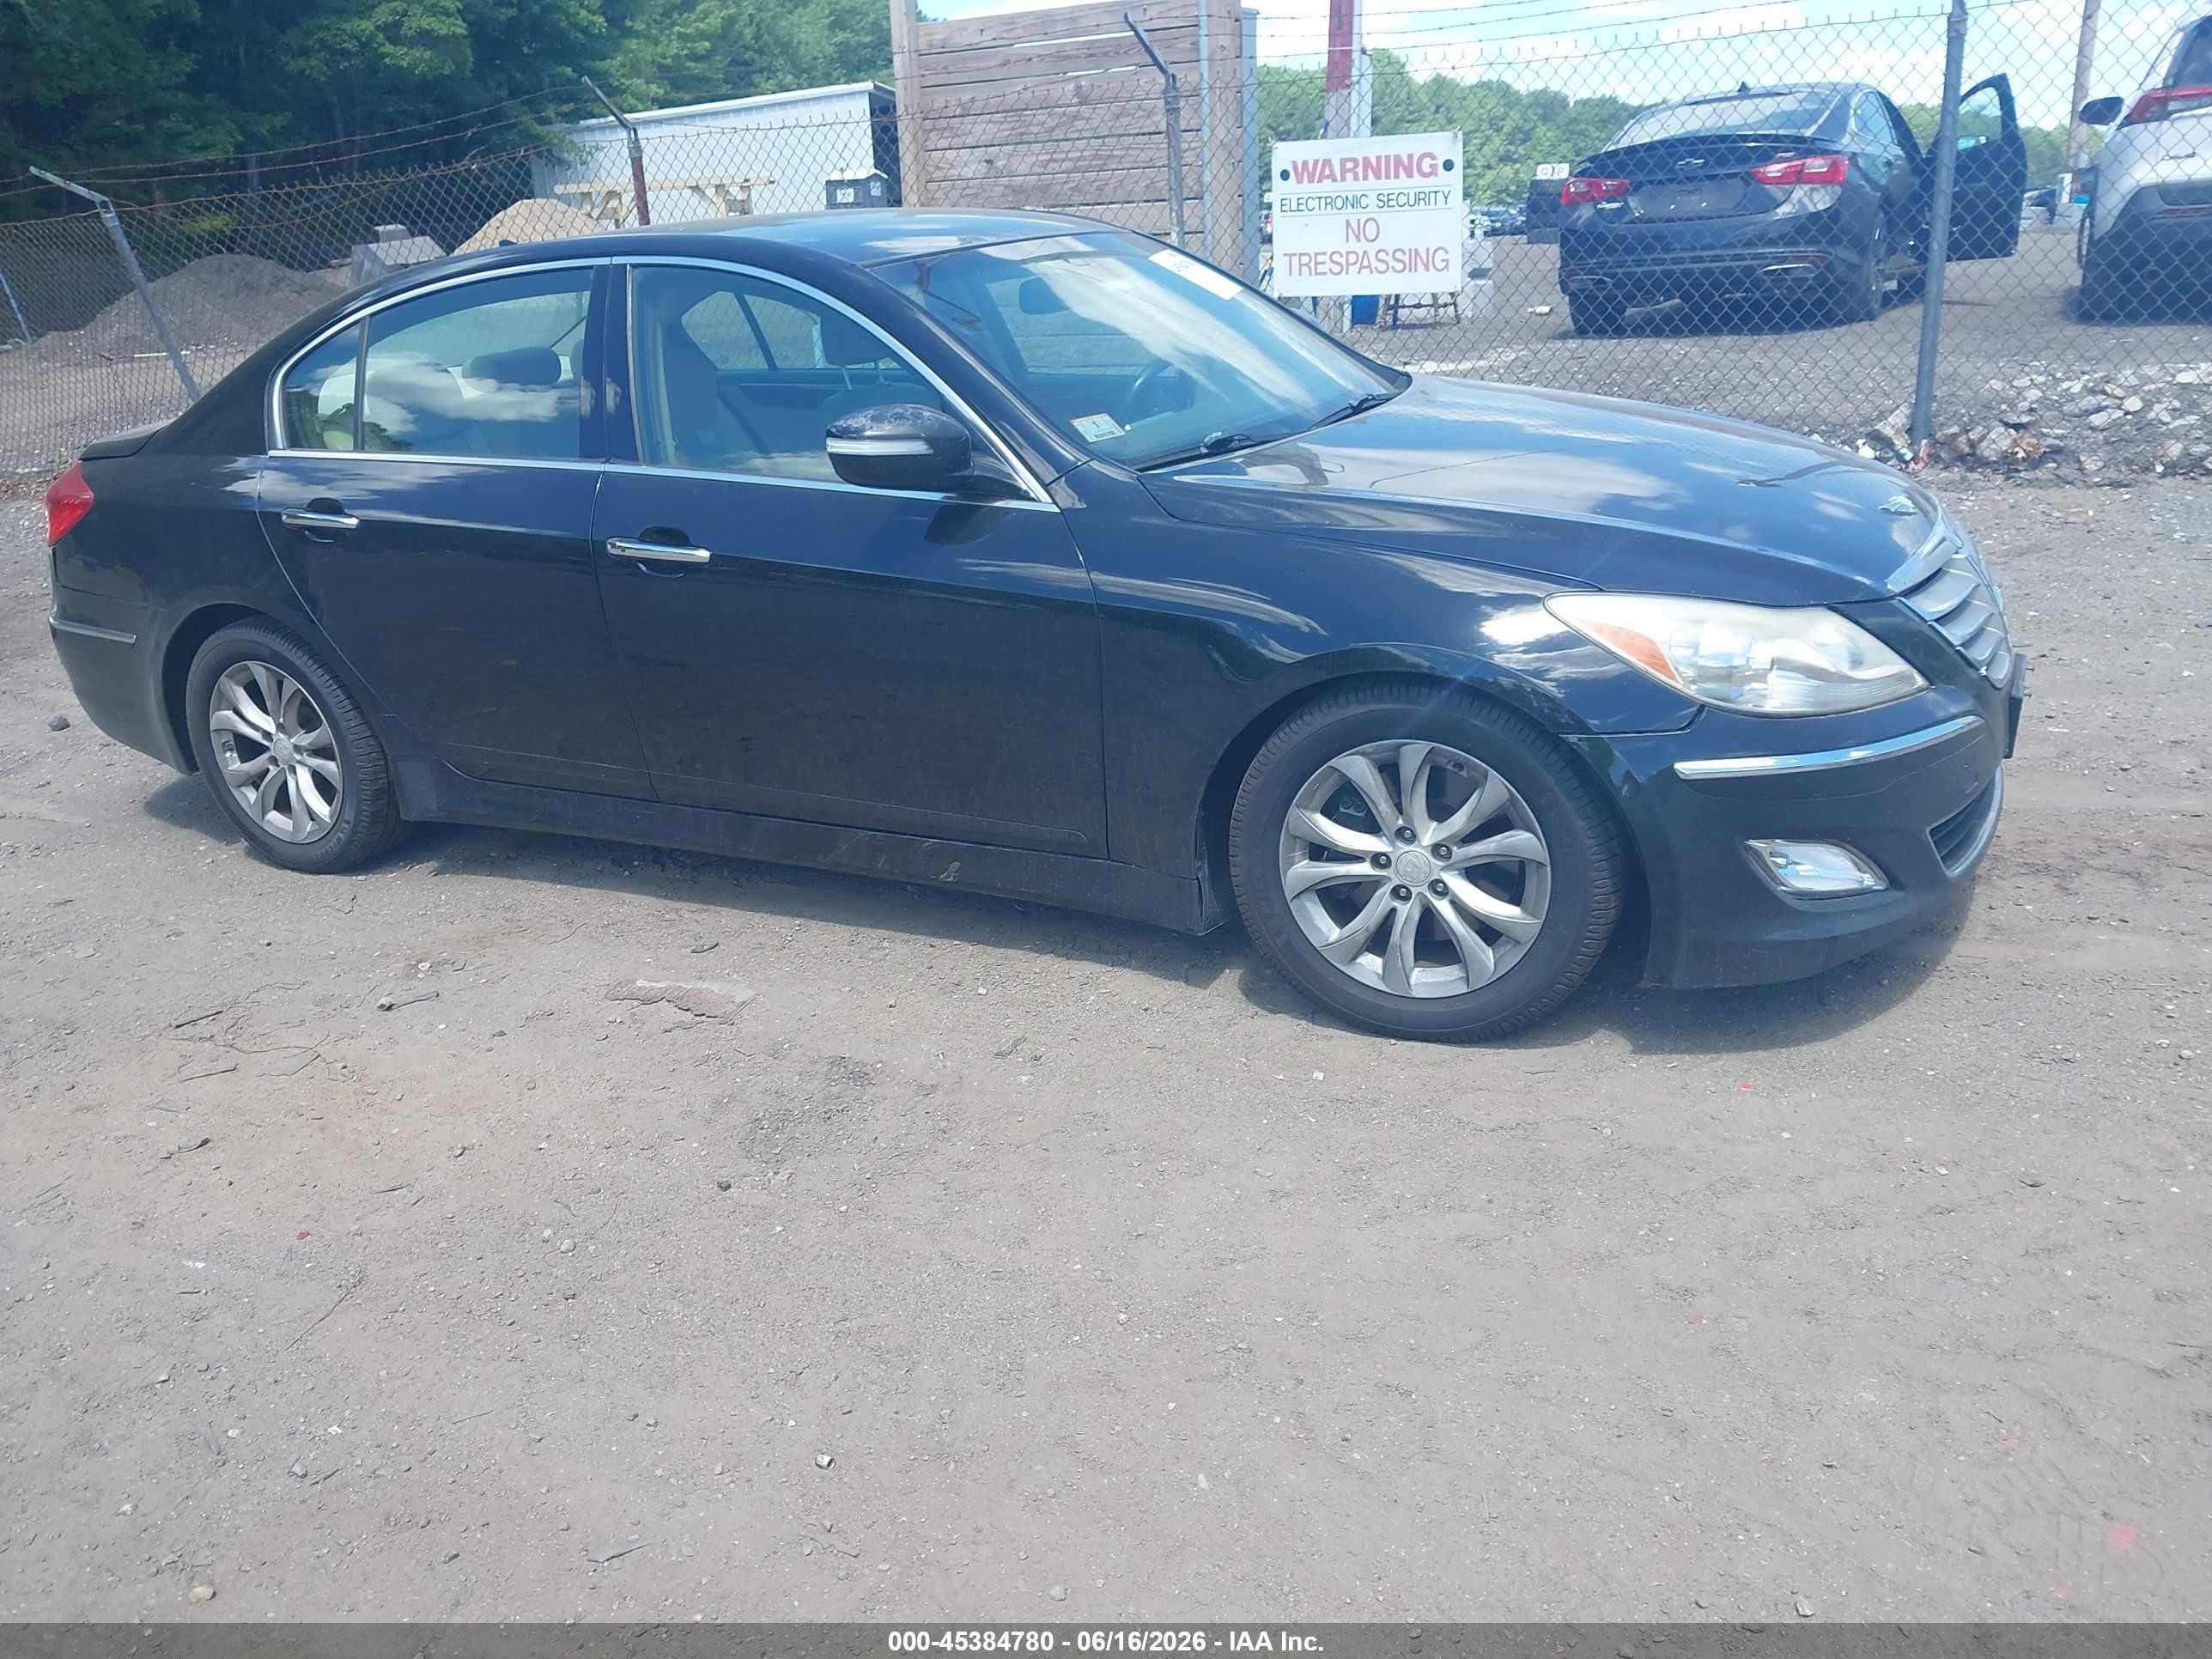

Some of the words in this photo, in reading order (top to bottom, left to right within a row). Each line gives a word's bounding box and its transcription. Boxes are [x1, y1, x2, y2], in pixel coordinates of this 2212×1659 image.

[1291, 151, 1439, 185] WARNING
[1279, 192, 1370, 213] ELECTRONIC
[1376, 189, 1451, 209] SECURITY
[1344, 216, 1381, 244] NO
[1283, 246, 1450, 277] TRESPASSING
